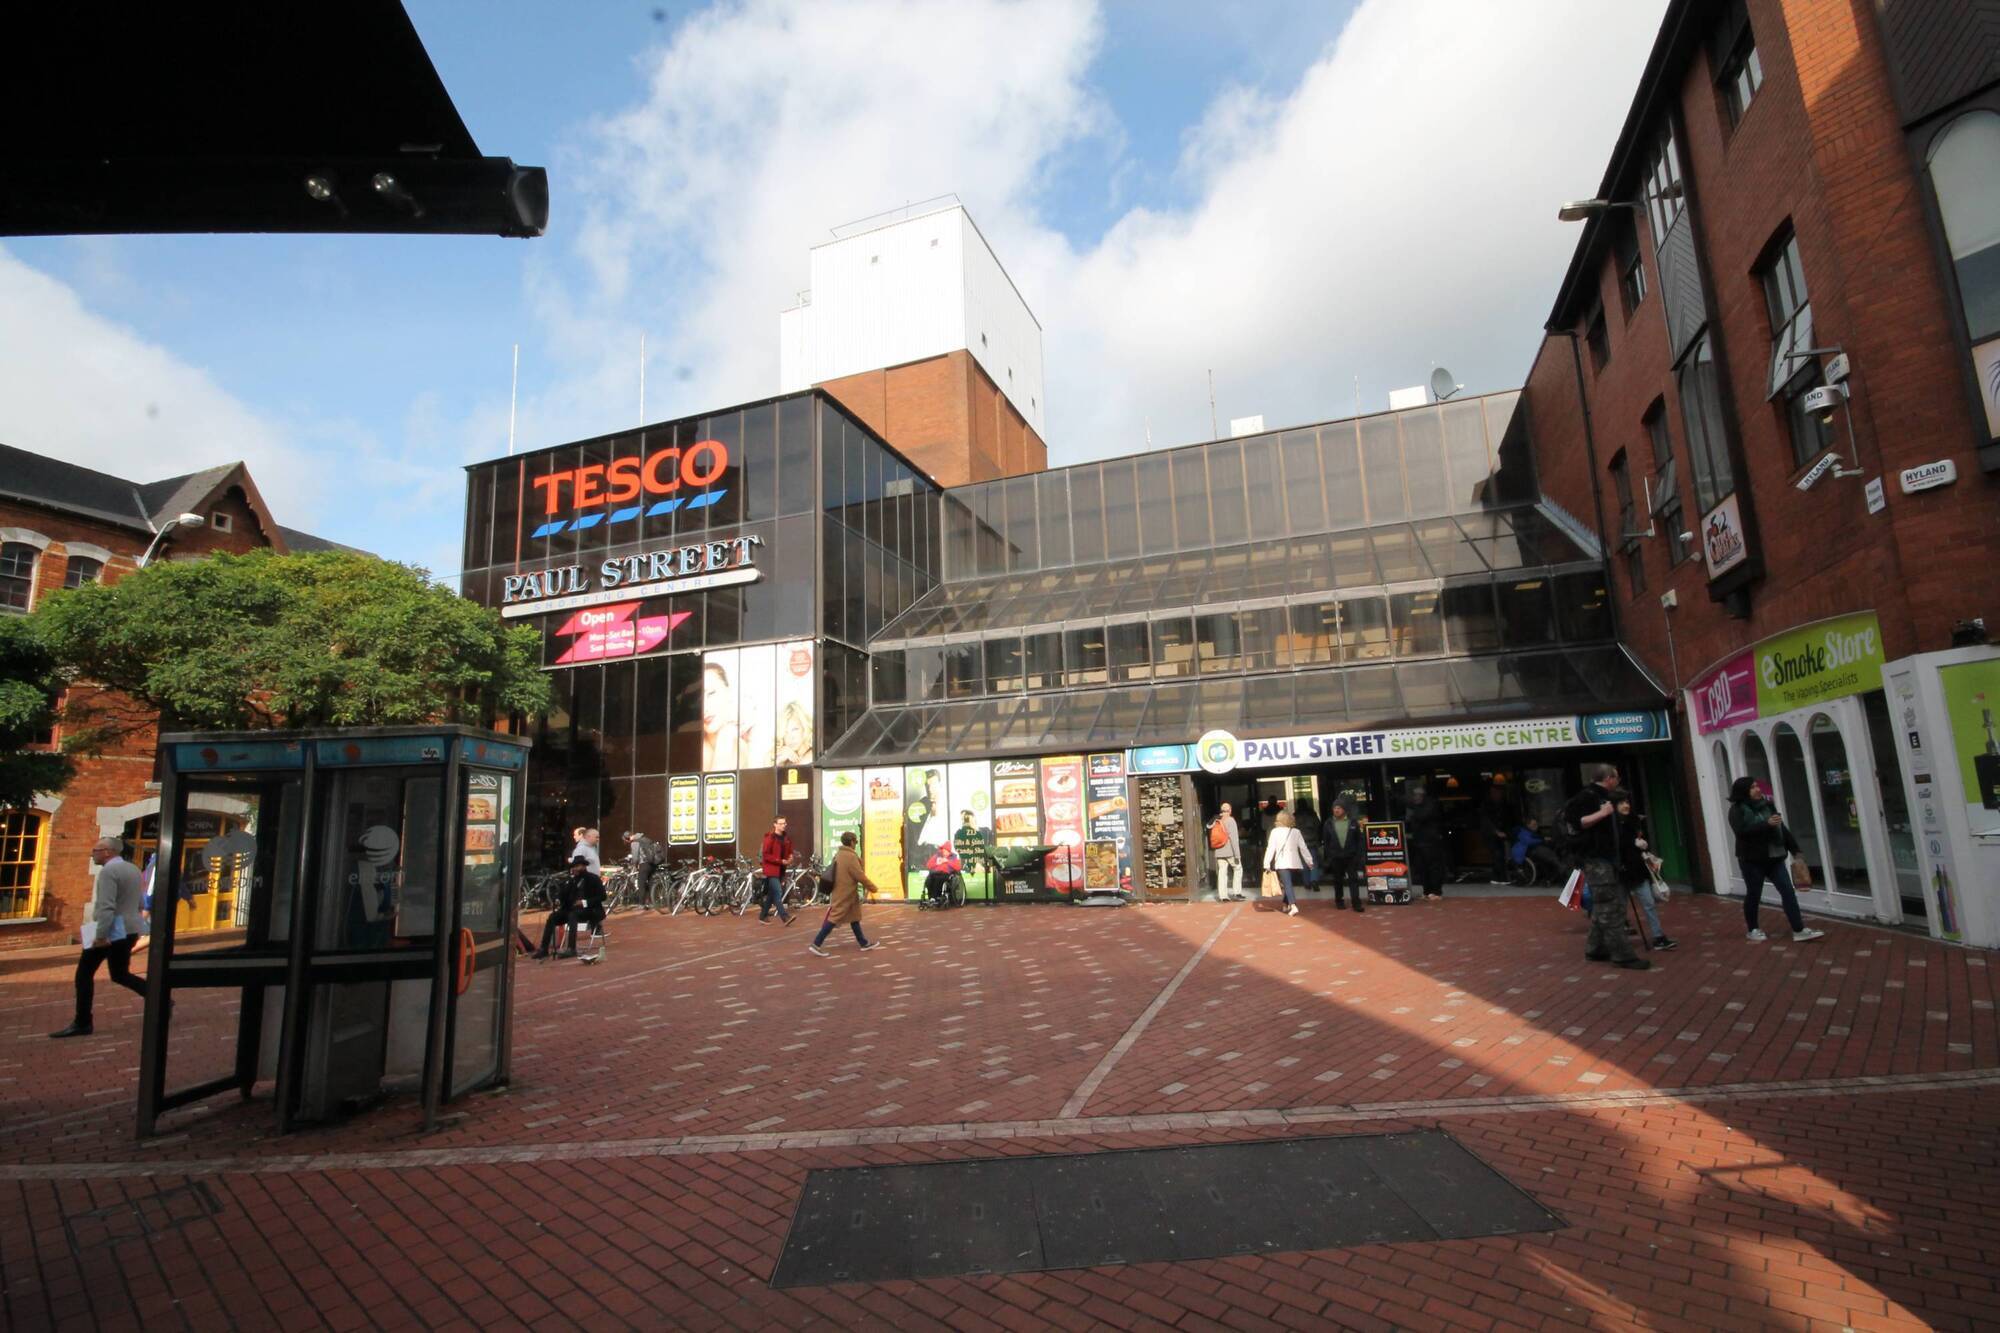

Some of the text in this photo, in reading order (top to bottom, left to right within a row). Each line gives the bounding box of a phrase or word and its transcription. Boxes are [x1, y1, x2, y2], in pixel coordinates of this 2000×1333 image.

[534, 440, 728, 515] TESCO
[1803, 458, 1830, 486] HYLAND
[1906, 465, 1947, 482] HYLAND
[504, 535, 763, 602] PAUL STREET
[534, 577, 715, 612] SHOPPING CENTRE
[581, 611, 615, 626] Open
[1819, 673, 1858, 692] Specialists
[1708, 670, 1732, 726] CBD
[1594, 715, 1643, 726] LATE NIGHT
[1596, 725, 1644, 736] SHOPPING
[1244, 727, 1573, 761] PAUL STREET SHOPPING CENTRE
[348, 870, 405, 888] ecom
